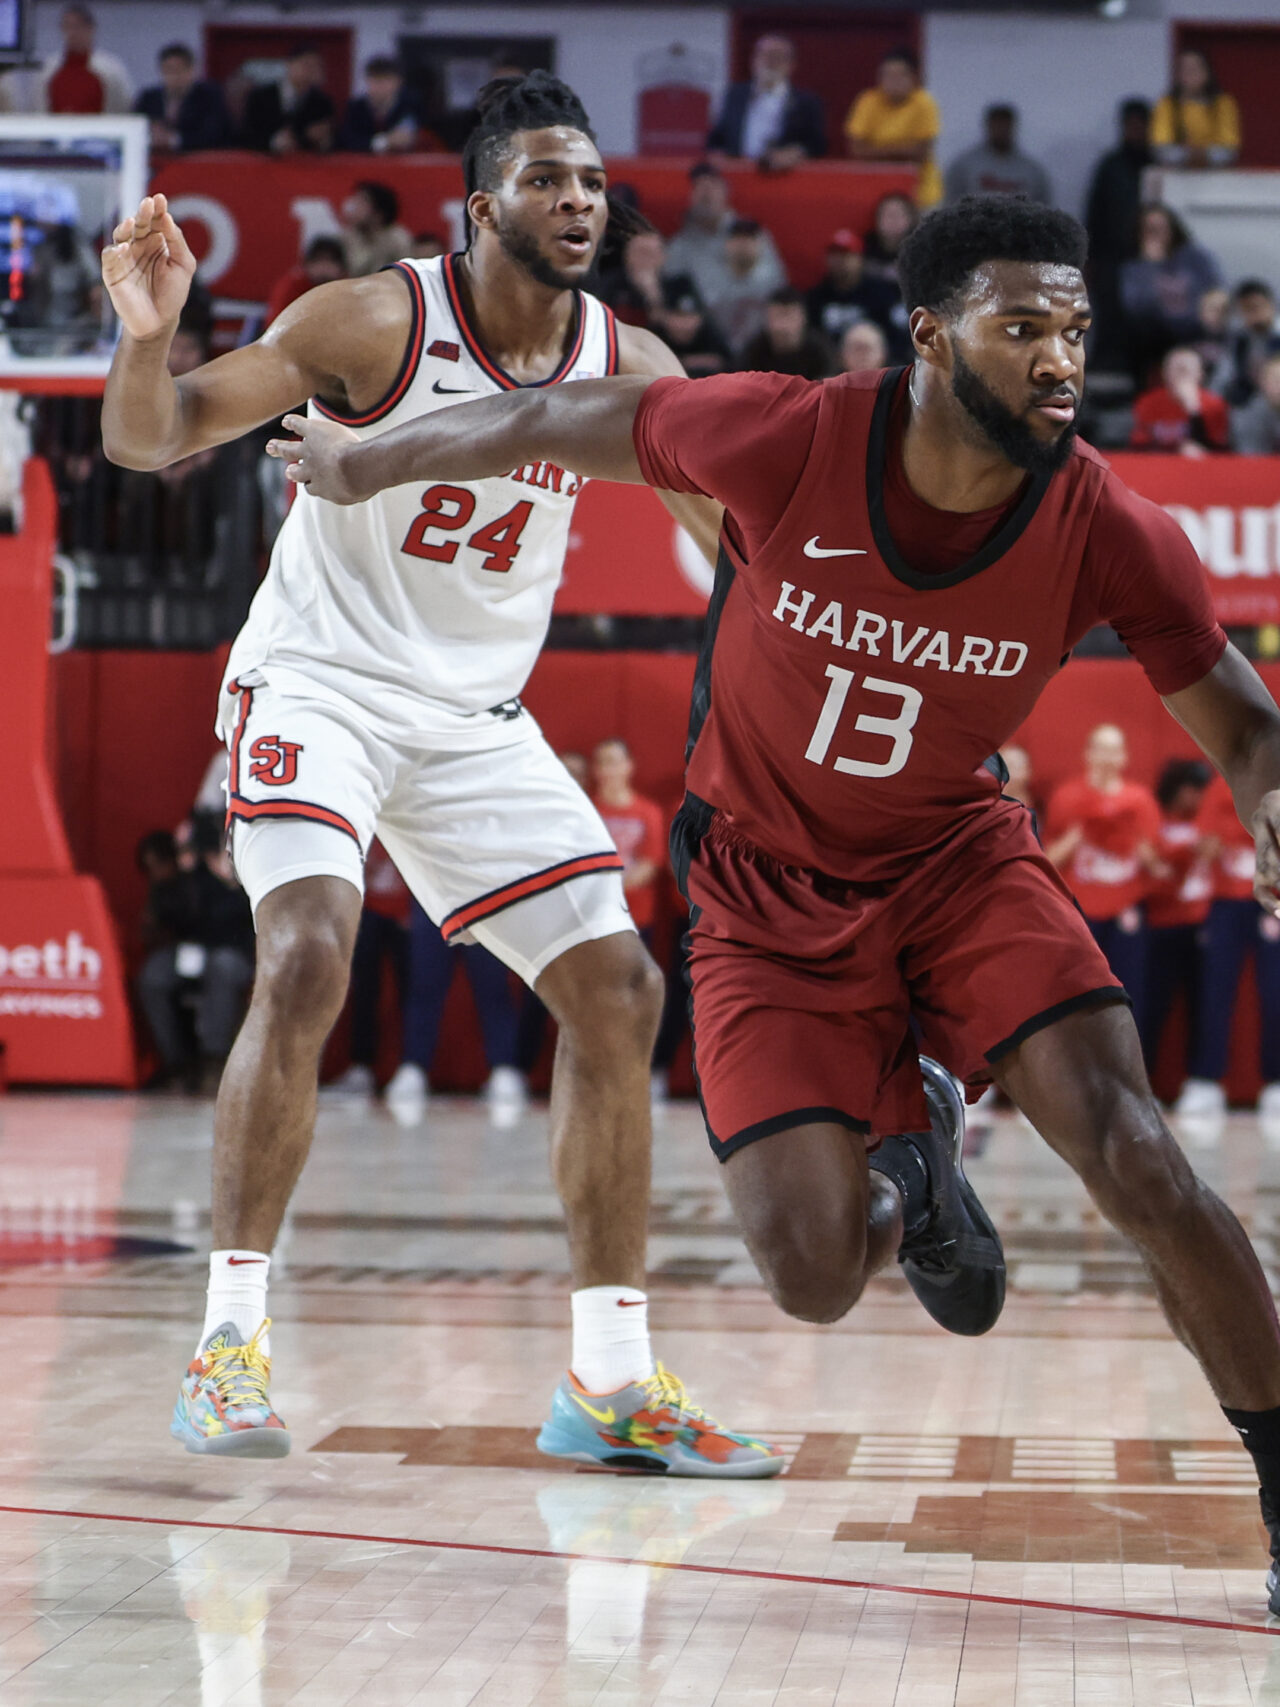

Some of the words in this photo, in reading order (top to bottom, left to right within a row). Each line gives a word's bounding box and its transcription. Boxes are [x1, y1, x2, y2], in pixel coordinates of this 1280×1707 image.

[401, 483, 534, 573] 24
[772, 580, 1029, 677] HARVARD
[248, 735, 304, 786] SJ
[804, 663, 924, 778] 13
[0, 930, 102, 980] eth
